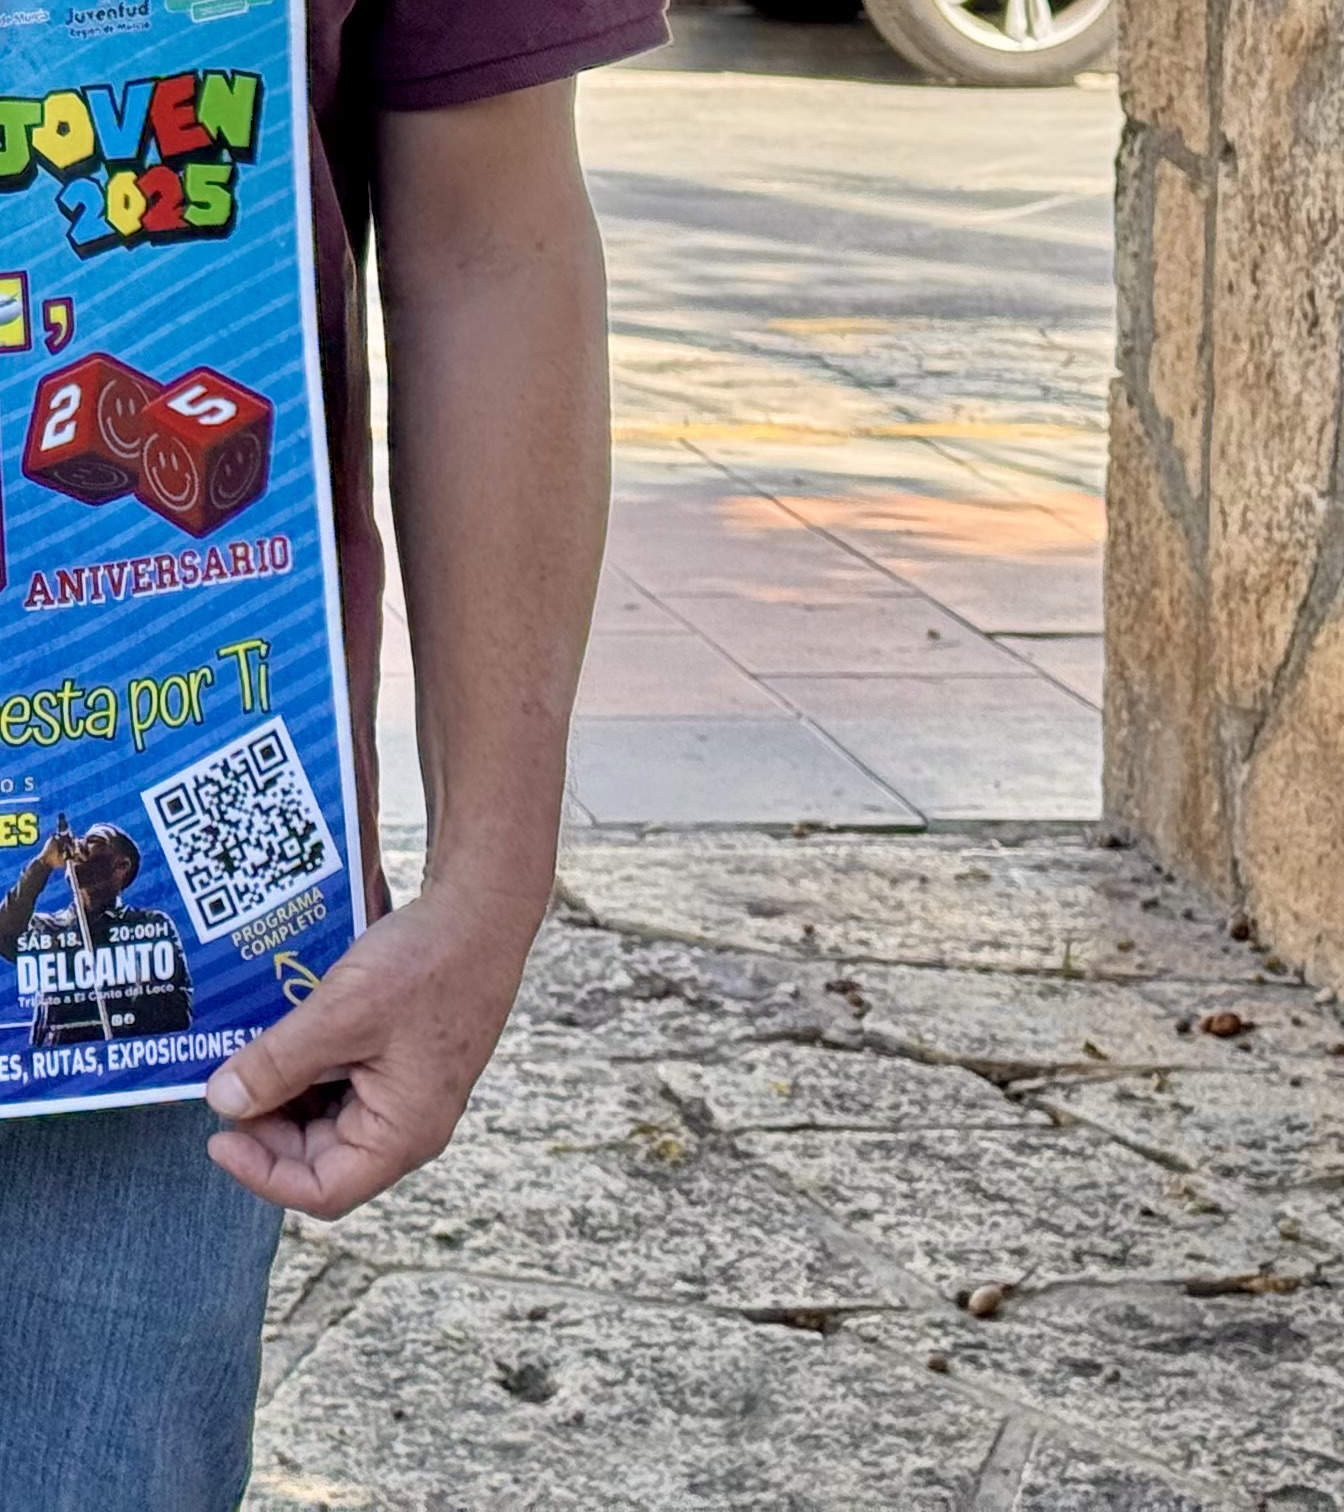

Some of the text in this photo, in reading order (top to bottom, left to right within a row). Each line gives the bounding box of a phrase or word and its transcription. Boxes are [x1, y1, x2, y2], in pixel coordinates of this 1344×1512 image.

[55, 163, 239, 260] 2025
[40, 383, 237, 451] 2 5
[23, 536, 293, 612] ANIVERSARIO
[128, 665, 212, 752] por
[216, 637, 272, 714] Ti
[109, 923, 169, 943] 20:00H
[231, 887, 325, 948] PROGRAMA
[240, 904, 327, 961] COMPLETO
[16, 941, 175, 996] DELCANTO
[33, 1046, 103, 1081] RUTAS,
[108, 1028, 247, 1071] EXPOSICIONES
